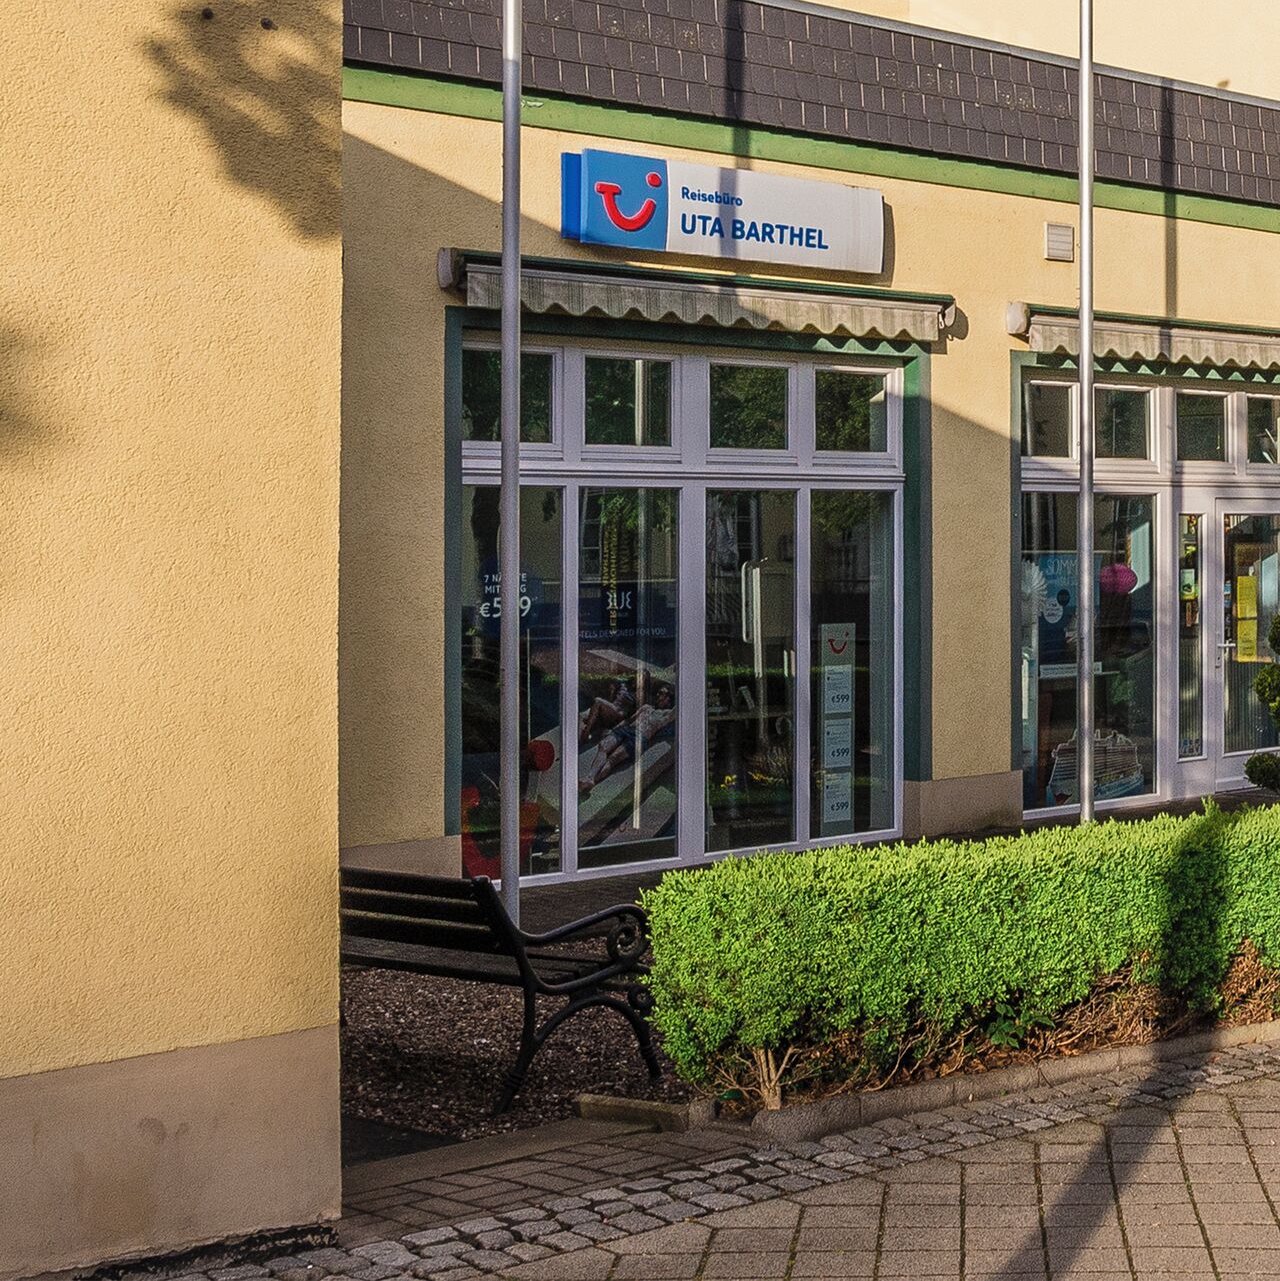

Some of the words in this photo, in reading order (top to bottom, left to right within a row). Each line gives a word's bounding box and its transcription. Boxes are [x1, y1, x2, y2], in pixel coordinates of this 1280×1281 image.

[681, 186, 743, 206] Reisebüro
[681, 213, 724, 238] UTA
[731, 219, 829, 250] BARTHEL
[484, 575, 489, 583] 7
[485, 586, 501, 594] MIT
[480, 596, 532, 618] €59
